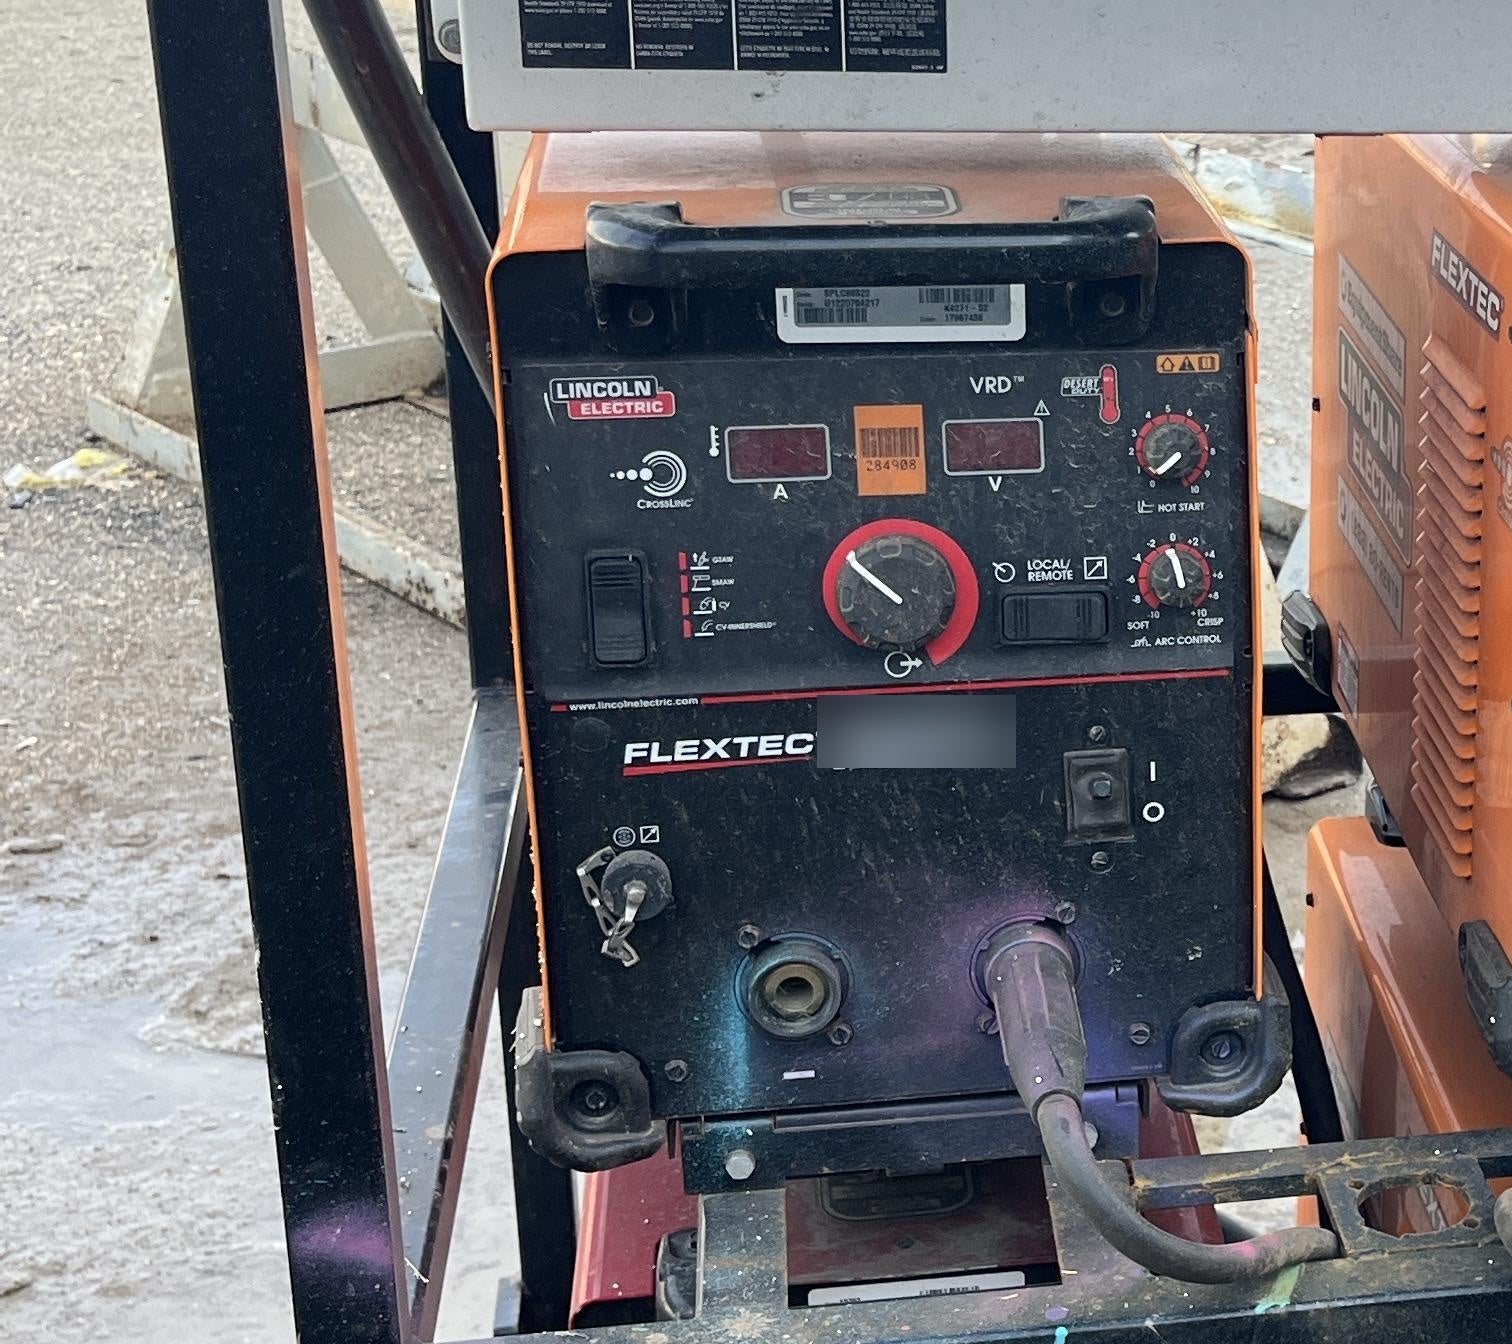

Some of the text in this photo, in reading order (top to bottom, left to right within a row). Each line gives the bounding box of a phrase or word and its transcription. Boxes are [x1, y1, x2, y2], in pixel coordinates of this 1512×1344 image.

[1432, 237, 1499, 332] FLEXTEC
[556, 380, 650, 399] LINCOLN
[1064, 378, 1099, 389] DESERT
[1071, 386, 1100, 395] DUTY
[580, 400, 664, 416] ELECTRIC
[1340, 343, 1398, 472] LINCOLN
[866, 459, 917, 472] 284908
[988, 476, 1002, 492] V
[1352, 430, 1404, 540] ELECTRIC
[773, 484, 789, 500] A
[1158, 502, 1204, 512] HOT START
[1027, 558, 1071, 570] LOCAL/
[1028, 569, 1074, 582] REMOTE
[1128, 621, 1150, 630] SOFT
[1197, 617, 1224, 626] CRISP
[1154, 634, 1222, 646] ARC CONTROL
[569, 696, 698, 712] www.lincolnelectric.com
[624, 732, 814, 764] FLEXTEC
